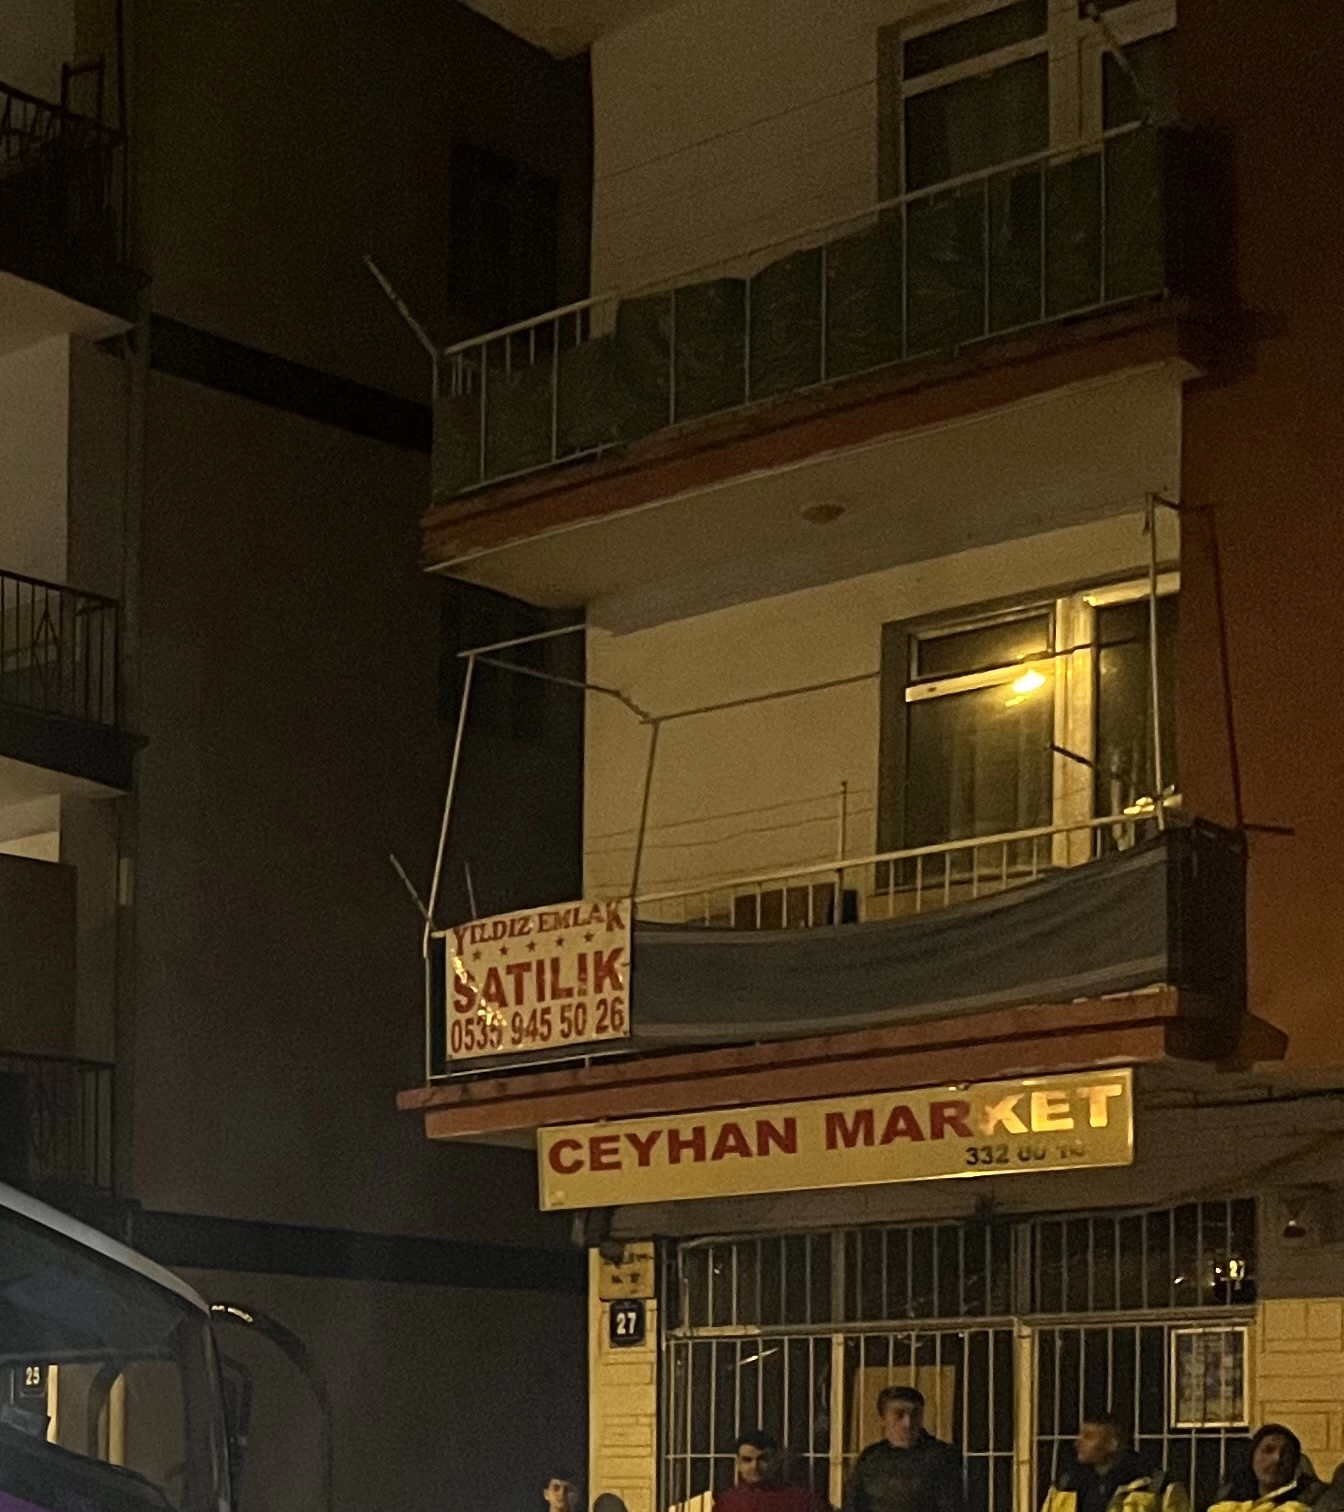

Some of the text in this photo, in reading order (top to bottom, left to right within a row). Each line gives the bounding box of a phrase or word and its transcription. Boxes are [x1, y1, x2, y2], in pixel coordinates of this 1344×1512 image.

[452, 900, 625, 956] YILDIZ EMLAK
[453, 947, 625, 1014] SATILIK
[511, 1007, 552, 1045] 945
[560, 1001, 587, 1039] 50
[595, 996, 625, 1035] 26
[548, 1084, 1123, 1175] CEYHAN MARKET
[616, 1312, 637, 1335] 27
[25, 1367, 41, 1386] 25
